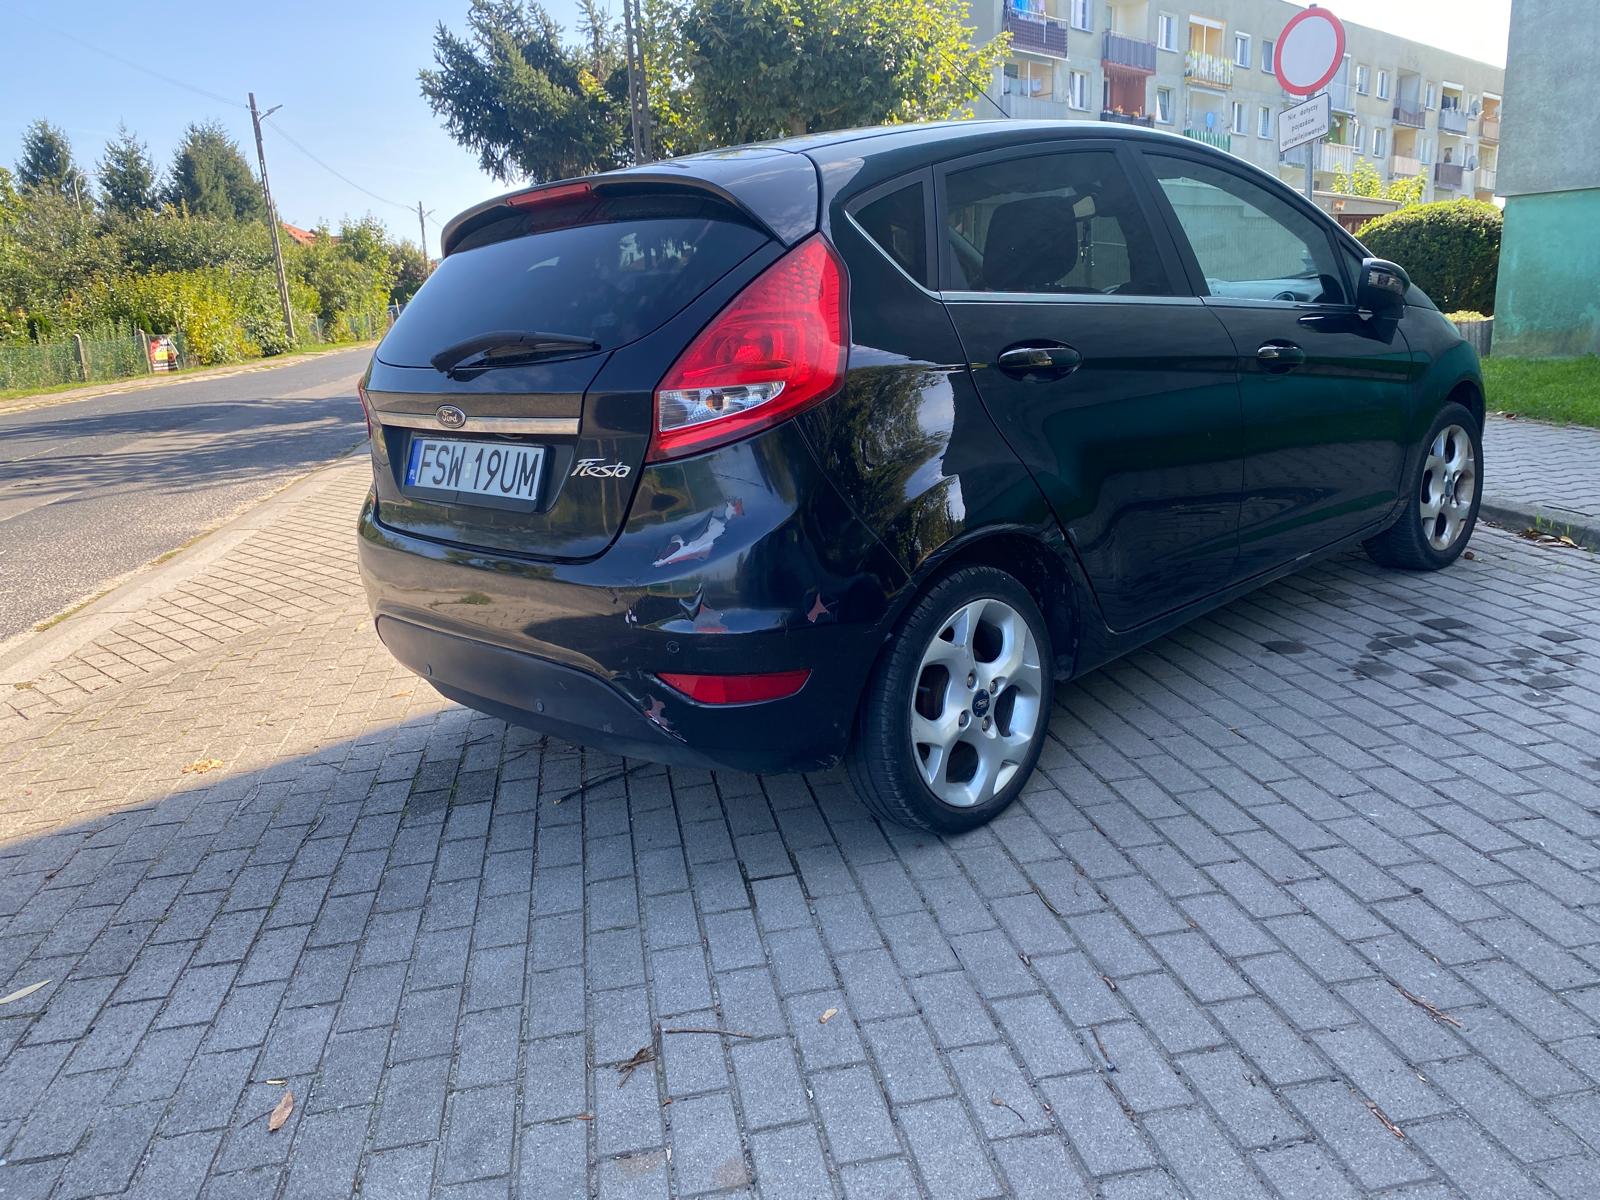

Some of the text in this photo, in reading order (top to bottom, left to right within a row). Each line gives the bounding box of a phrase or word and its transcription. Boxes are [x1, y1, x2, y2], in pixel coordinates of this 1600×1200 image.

[440, 408, 459, 424] Ford
[417, 444, 540, 497] FSW 19UM
[570, 457, 632, 479] Fiesta
